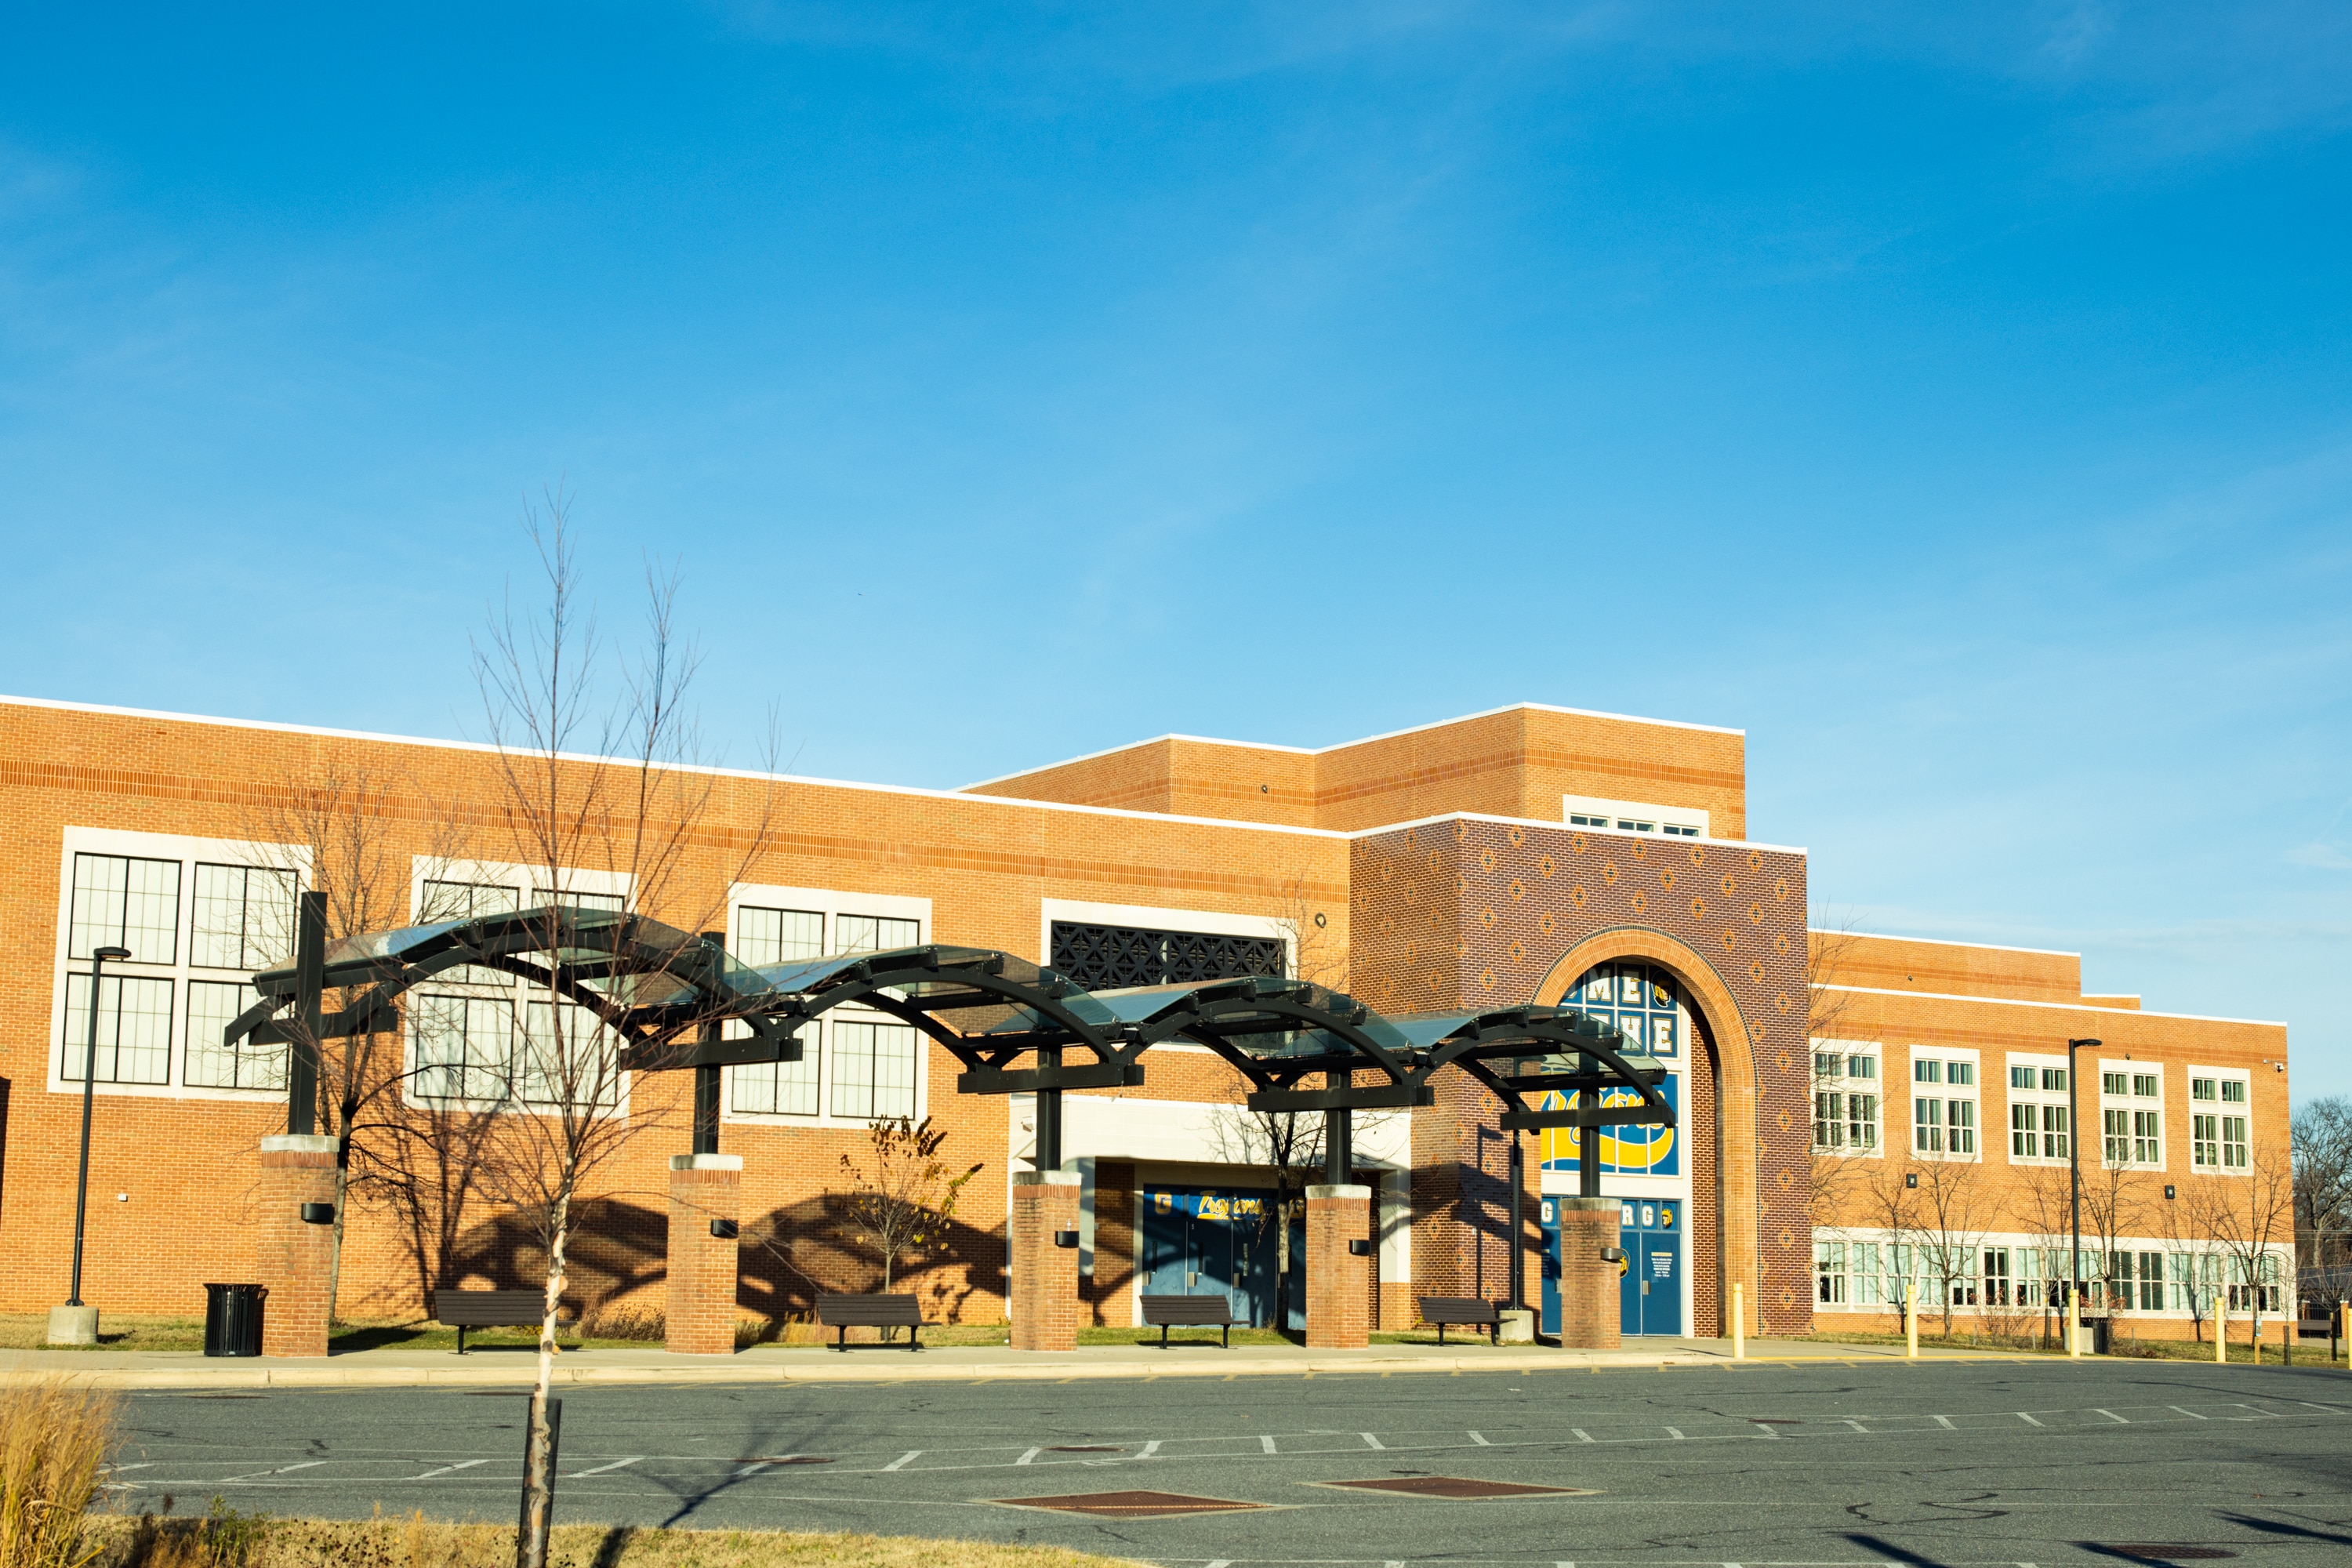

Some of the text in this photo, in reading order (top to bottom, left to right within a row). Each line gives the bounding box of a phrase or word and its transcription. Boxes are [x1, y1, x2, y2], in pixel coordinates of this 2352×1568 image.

[1565, 967, 1641, 1004] ME
[1154, 1192, 1172, 1214] G
[1198, 1189, 1265, 1220] Trojans
